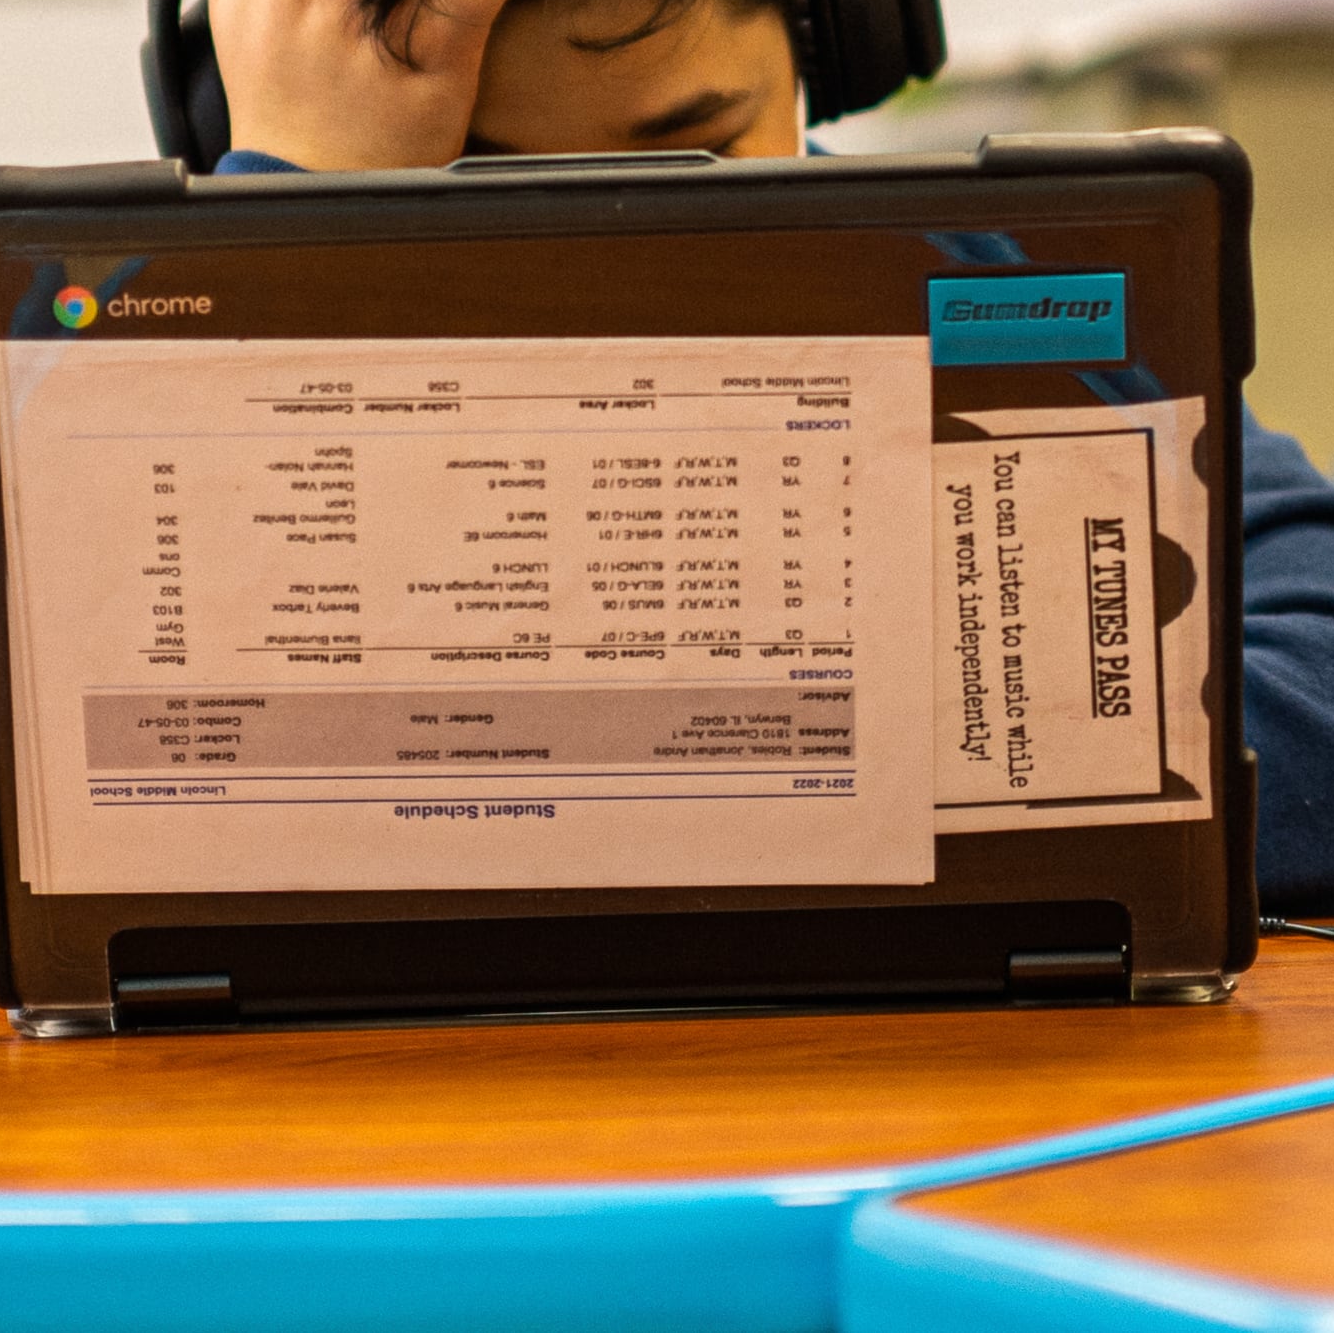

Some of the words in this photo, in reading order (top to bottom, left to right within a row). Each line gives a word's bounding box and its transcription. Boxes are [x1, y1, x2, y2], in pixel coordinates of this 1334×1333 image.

[107, 292, 213, 317] chrome
[940, 297, 1113, 323] Gumdrop
[633, 379, 654, 389] 302
[722, 377, 761, 388] School
[765, 377, 804, 387] Middle
[807, 376, 850, 386] Lincoln
[300, 383, 353, 394] 03-05-47
[579, 401, 608, 410] Area
[613, 400, 655, 409] Locker
[797, 396, 850, 408] Building
[273, 403, 353, 414] Combination
[365, 403, 413, 413] Number
[417, 403, 460, 412] Locker
[786, 419, 850, 431] LOCKERS
[307, 462, 353, 471] Hannah
[446, 460, 509, 469] Newcomer
[522, 459, 545, 470] ESL
[593, 459, 606, 469] 01
[783, 456, 801, 467] Q3
[153, 464, 174, 474] 306
[994, 452, 1020, 492] You
[499, 479, 545, 489] Science
[593, 478, 607, 489] 07
[782, 477, 800, 486] YR
[843, 475, 850, 486] 7
[154, 483, 175, 494] 103
[321, 481, 354, 491] David
[947, 485, 973, 526] you
[507, 513, 515, 522] 6
[517, 512, 547, 521] Math
[783, 509, 801, 519] YR
[996, 499, 1018, 537] can
[157, 515, 177, 526] 304
[465, 531, 479, 542] 6E
[483, 531, 547, 539] Homeroom
[599, 530, 613, 540] 01
[783, 528, 801, 537] YR
[1091, 518, 1125, 553] MY
[157, 535, 178, 545] 306
[287, 534, 316, 544] Pace
[319, 533, 356, 543] Susan
[159, 553, 180, 561] ons
[955, 533, 981, 586] work
[493, 563, 501, 573] 6
[503, 563, 548, 573] LUNCH
[587, 562, 601, 572] 01
[611, 561, 664, 572] 6LUNCH
[784, 561, 801, 570] YR
[143, 567, 181, 577] Comm
[445, 580, 503, 591] Language
[784, 580, 801, 589] YR
[844, 577, 851, 588] 3
[998, 544, 1024, 617] listen
[160, 586, 181, 596] 302
[289, 585, 315, 595] Diaz
[407, 583, 415, 593] 6
[418, 583, 441, 593] Arts
[506, 580, 549, 592] English
[592, 581, 607, 591] 05
[455, 602, 463, 612] 6
[466, 601, 499, 611] Music
[503, 601, 549, 611] General
[628, 599, 664, 610] 6MUS
[785, 597, 803, 608] Q3
[845, 597, 852, 607] 2
[1093, 560, 1128, 647] TUNES
[153, 605, 183, 615] B103
[316, 602, 359, 613] Beverly
[156, 621, 184, 633] Gym
[513, 633, 530, 643] 6C
[534, 633, 551, 643] PE
[601, 632, 616, 642] 07
[627, 631, 665, 642] 6PE-C
[785, 629, 803, 640] Q3
[1002, 625, 1026, 647] to
[155, 637, 185, 647] West
[431, 651, 502, 661] Description
[505, 651, 550, 661] Course
[585, 650, 617, 660] Code
[621, 650, 665, 659] Course
[710, 646, 740, 658] Days
[760, 645, 803, 657] Length
[812, 647, 852, 657] Period
[149, 655, 185, 665] Room
[288, 654, 329, 663] Names
[333, 653, 361, 663] Staff
[789, 669, 853, 680] COURSES
[955, 594, 992, 761] independently!
[1003, 655, 1029, 718] music
[1097, 655, 1131, 718] PASS
[799, 692, 851, 701] Advisor:
[167, 700, 187, 710] 306
[195, 698, 265, 708] Homeroom:
[138, 717, 189, 728] 03-05-47
[193, 717, 241, 727] Combo:
[410, 715, 438, 724] Male
[446, 714, 494, 724] Gender:
[682, 730, 704, 739] Ave
[708, 729, 759, 739] Clarence
[798, 728, 850, 737] Address
[195, 734, 240, 744] Locker:
[447, 750, 499, 759] Number:
[502, 749, 550, 759] Student
[653, 747, 688, 757] Andre
[691, 746, 744, 756] Jonathan
[799, 746, 851, 756] Student:
[196, 752, 237, 762] Grade:
[1006, 725, 1033, 788] while
[793, 778, 854, 789] 2021-2022
[90, 787, 133, 797] School
[137, 787, 177, 796] Middle
[181, 786, 226, 795] Lincoln
[395, 805, 479, 819] Schedule
[485, 804, 555, 818] Student
